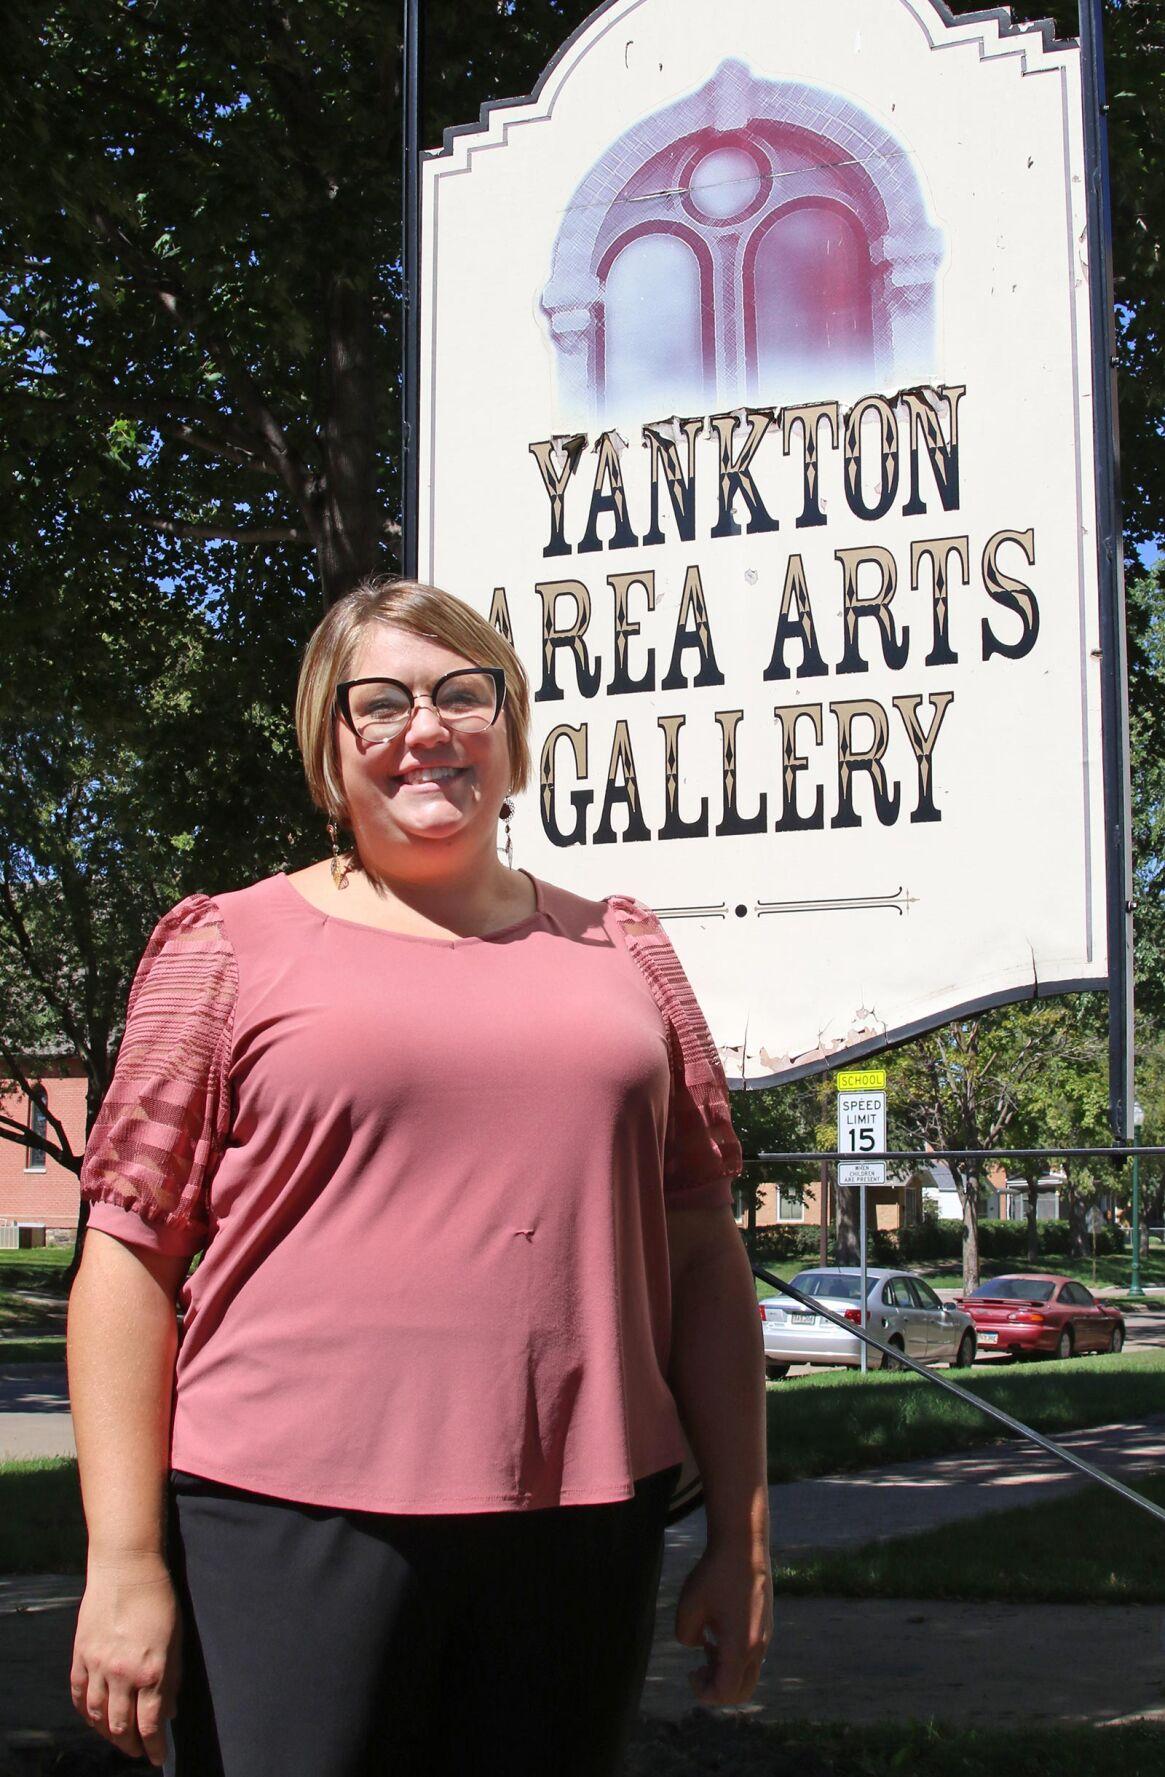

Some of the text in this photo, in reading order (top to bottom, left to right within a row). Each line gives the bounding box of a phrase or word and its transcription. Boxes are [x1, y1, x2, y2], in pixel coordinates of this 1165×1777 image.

[528, 384, 967, 558] YANKTON
[763, 528, 1041, 681] ARTS
[539, 691, 955, 848] GALLERY
[841, 1074, 882, 1087] SCHOOL
[842, 1100, 882, 1111] SPEED
[846, 1114, 877, 1125] LIMIT
[848, 1128, 876, 1152] 15
